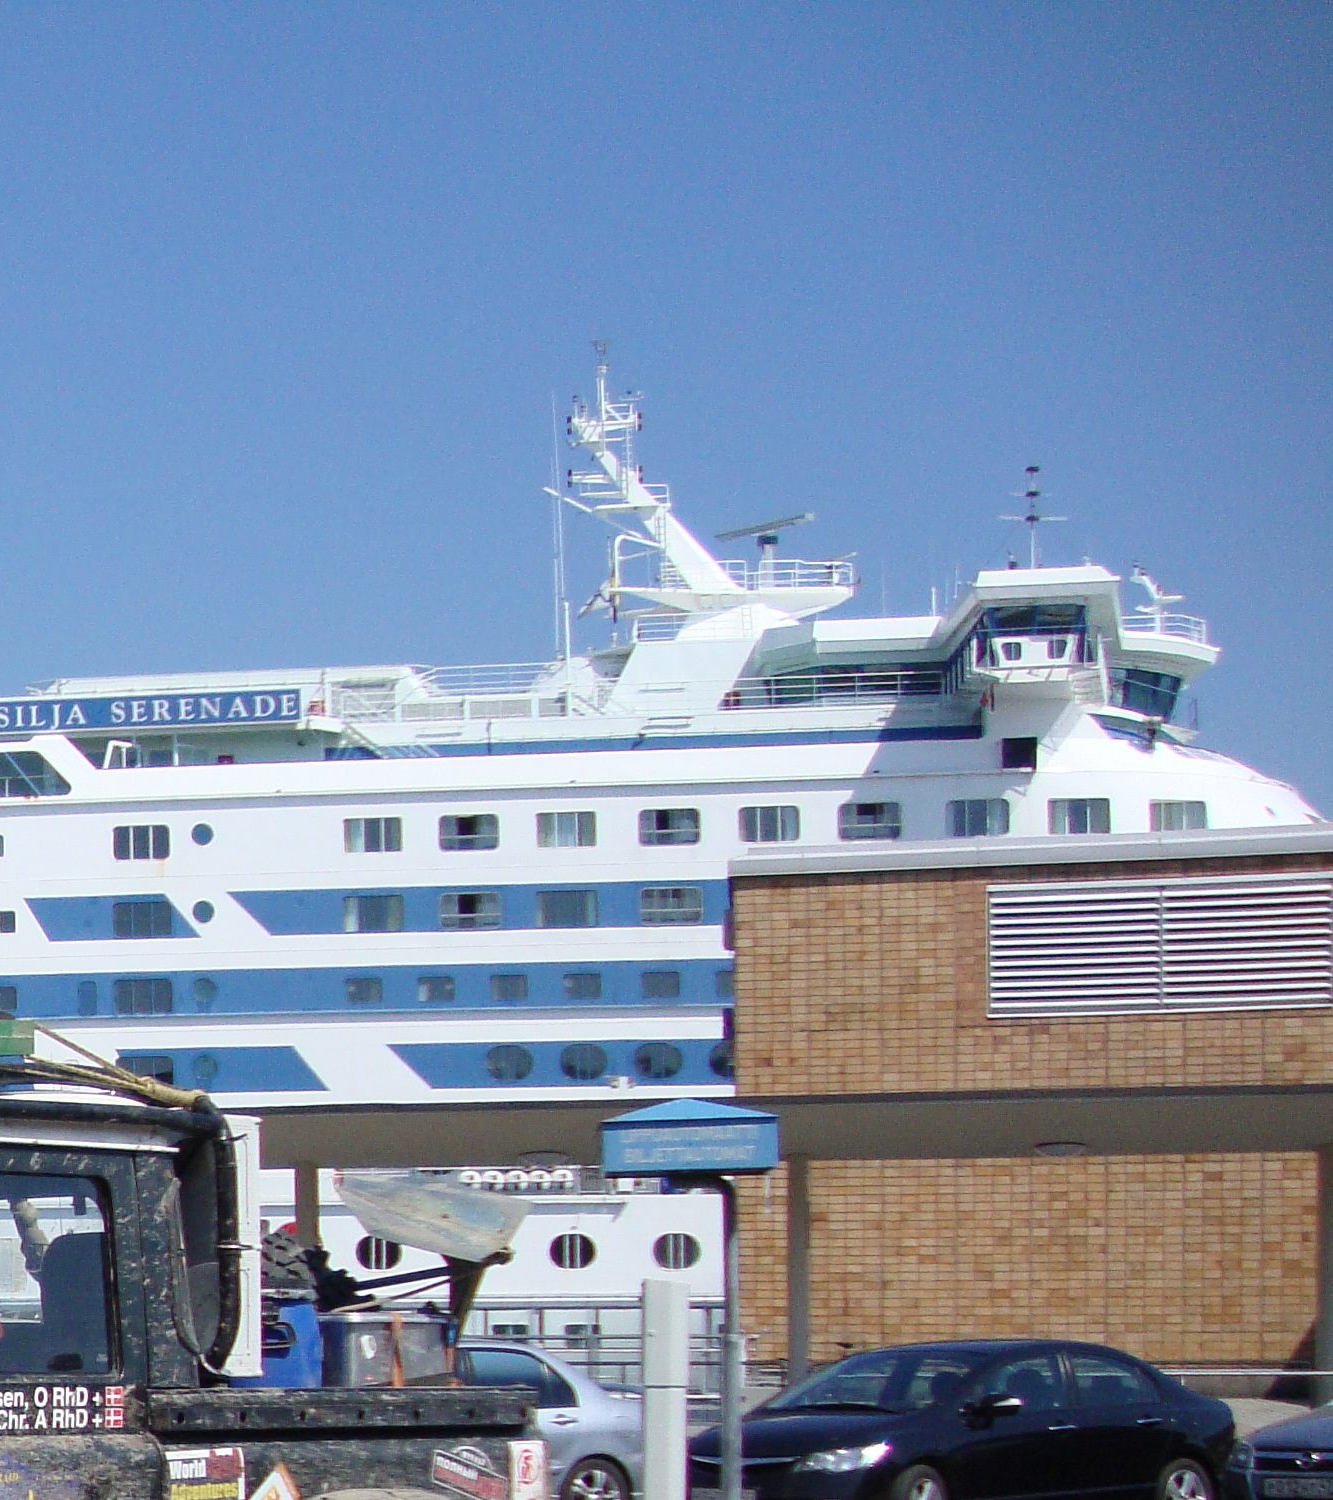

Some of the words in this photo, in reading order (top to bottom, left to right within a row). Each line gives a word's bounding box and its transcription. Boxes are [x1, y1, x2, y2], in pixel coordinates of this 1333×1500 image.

[110, 693, 298, 724] SERENADE
[52, 1386, 89, 1407] RhD
[34, 1409, 48, 1429] A
[52, 1408, 89, 1428] RhD
[169, 1458, 207, 1479] World
